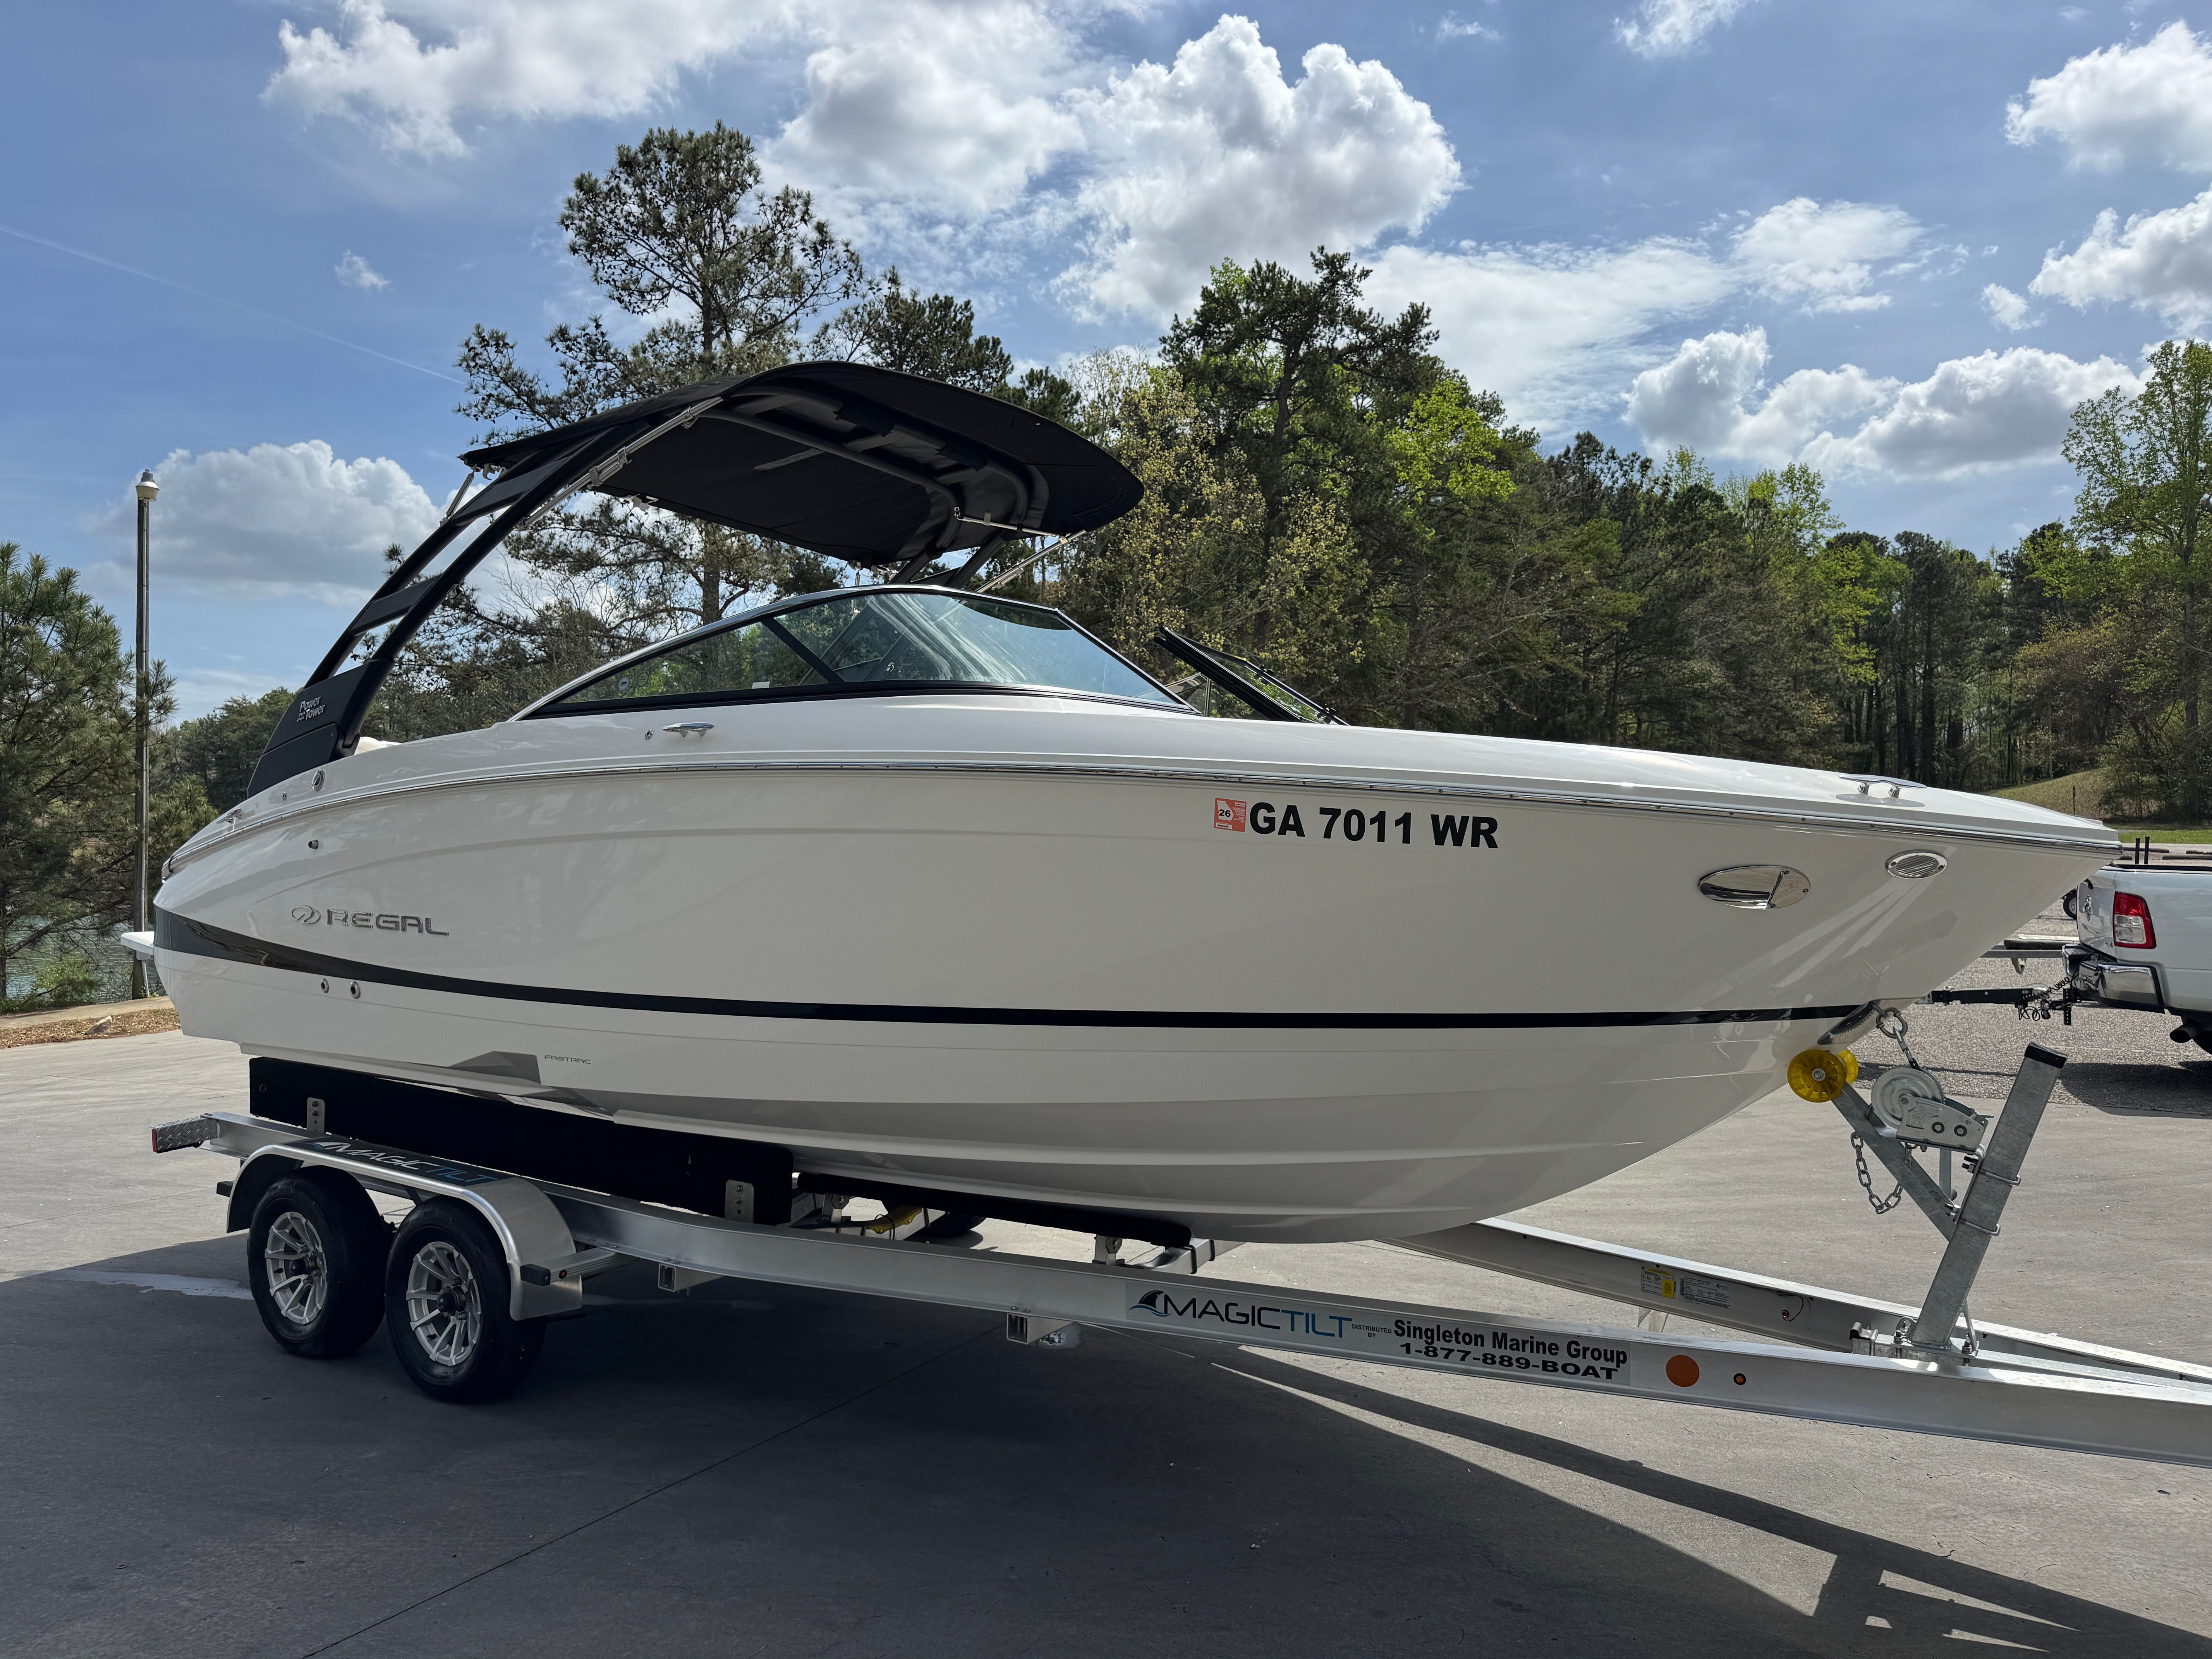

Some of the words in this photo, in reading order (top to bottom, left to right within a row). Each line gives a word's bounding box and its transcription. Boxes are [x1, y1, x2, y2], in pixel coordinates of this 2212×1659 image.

[299, 696, 321, 713] Power
[306, 704, 325, 720] Tower
[1219, 809, 1231, 817] 26
[1249, 802, 1305, 837] GA
[1319, 807, 1412, 844] 7011
[1431, 814, 1498, 848] WR
[327, 909, 449, 936] REGAL
[544, 1055, 591, 1064] FASTRAC
[325, 1144, 499, 1182] MAGICTILT
[1164, 1293, 1352, 1338] MAGICTILT
[1352, 1324, 1392, 1333] DISTRIBUTED
[1394, 1319, 1485, 1348] Singleton
[1492, 1330, 1559, 1356] Marine
[1566, 1340, 1627, 1369] Group
[1400, 1342, 1618, 1380] 1-877-889-BOAT
